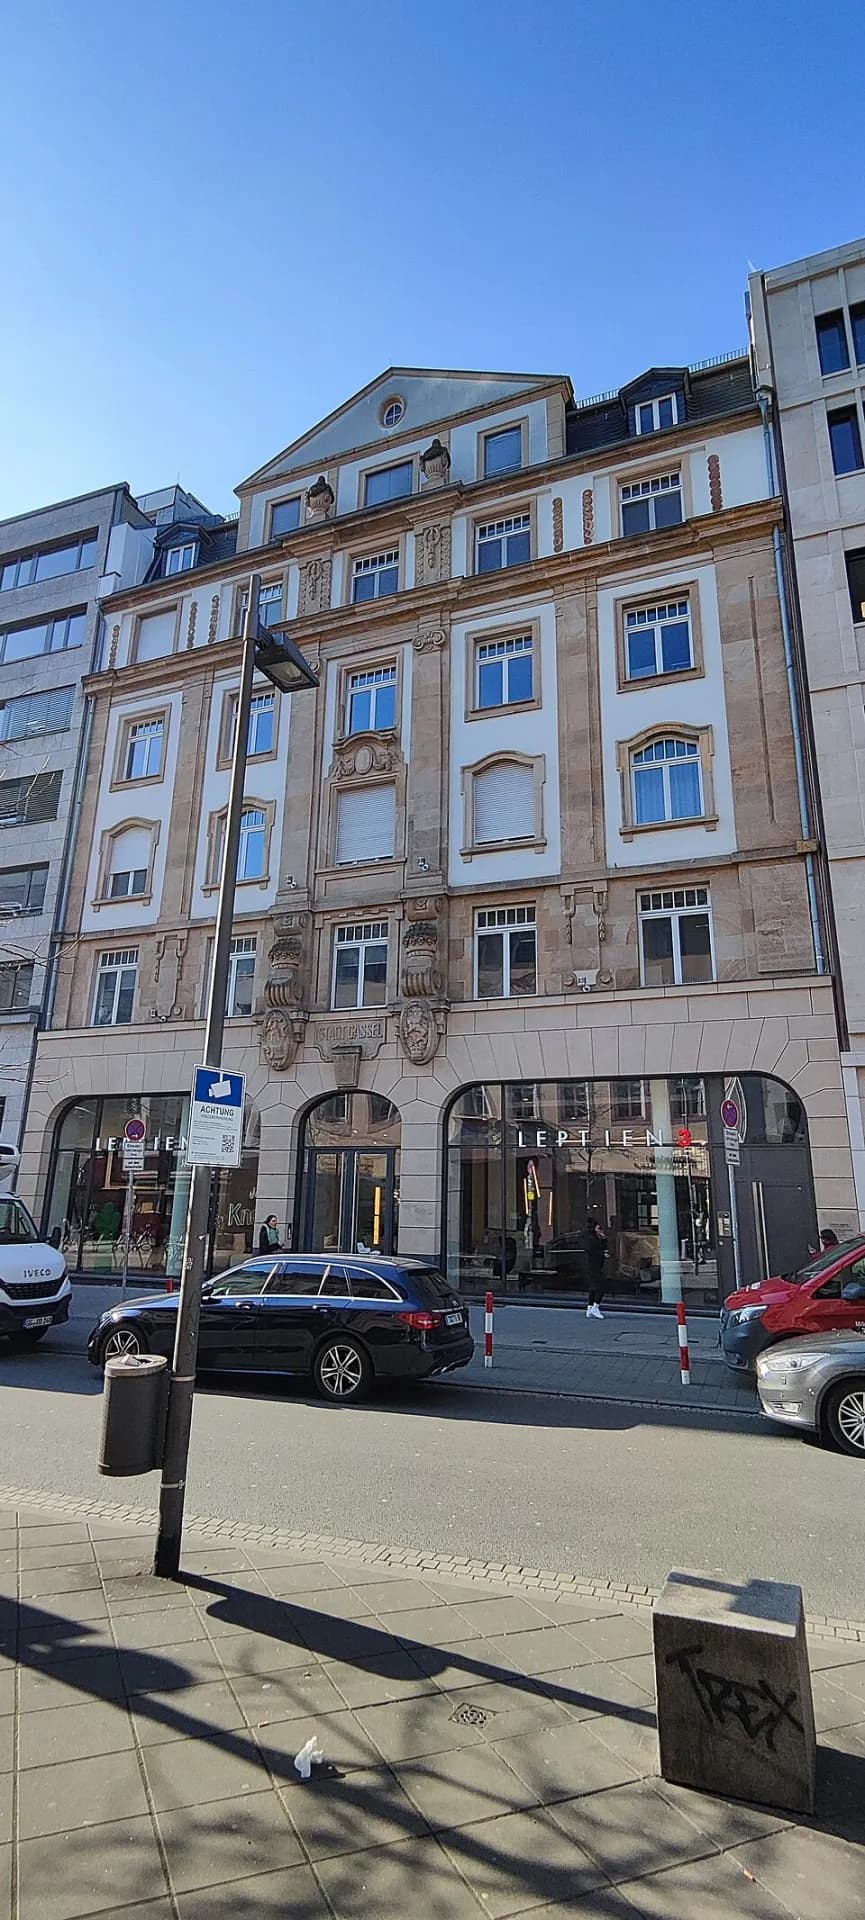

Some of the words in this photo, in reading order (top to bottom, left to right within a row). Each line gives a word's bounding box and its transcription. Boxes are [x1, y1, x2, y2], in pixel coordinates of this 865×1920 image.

[348, 1022, 384, 1039] CASSEL
[200, 1105, 234, 1117] ACHTUNG
[95, 1136, 188, 1151] LEIEN
[518, 1129, 663, 1148] LEPTIEN
[676, 1128, 692, 1147] 3
[23, 1268, 52, 1278] IVECO
